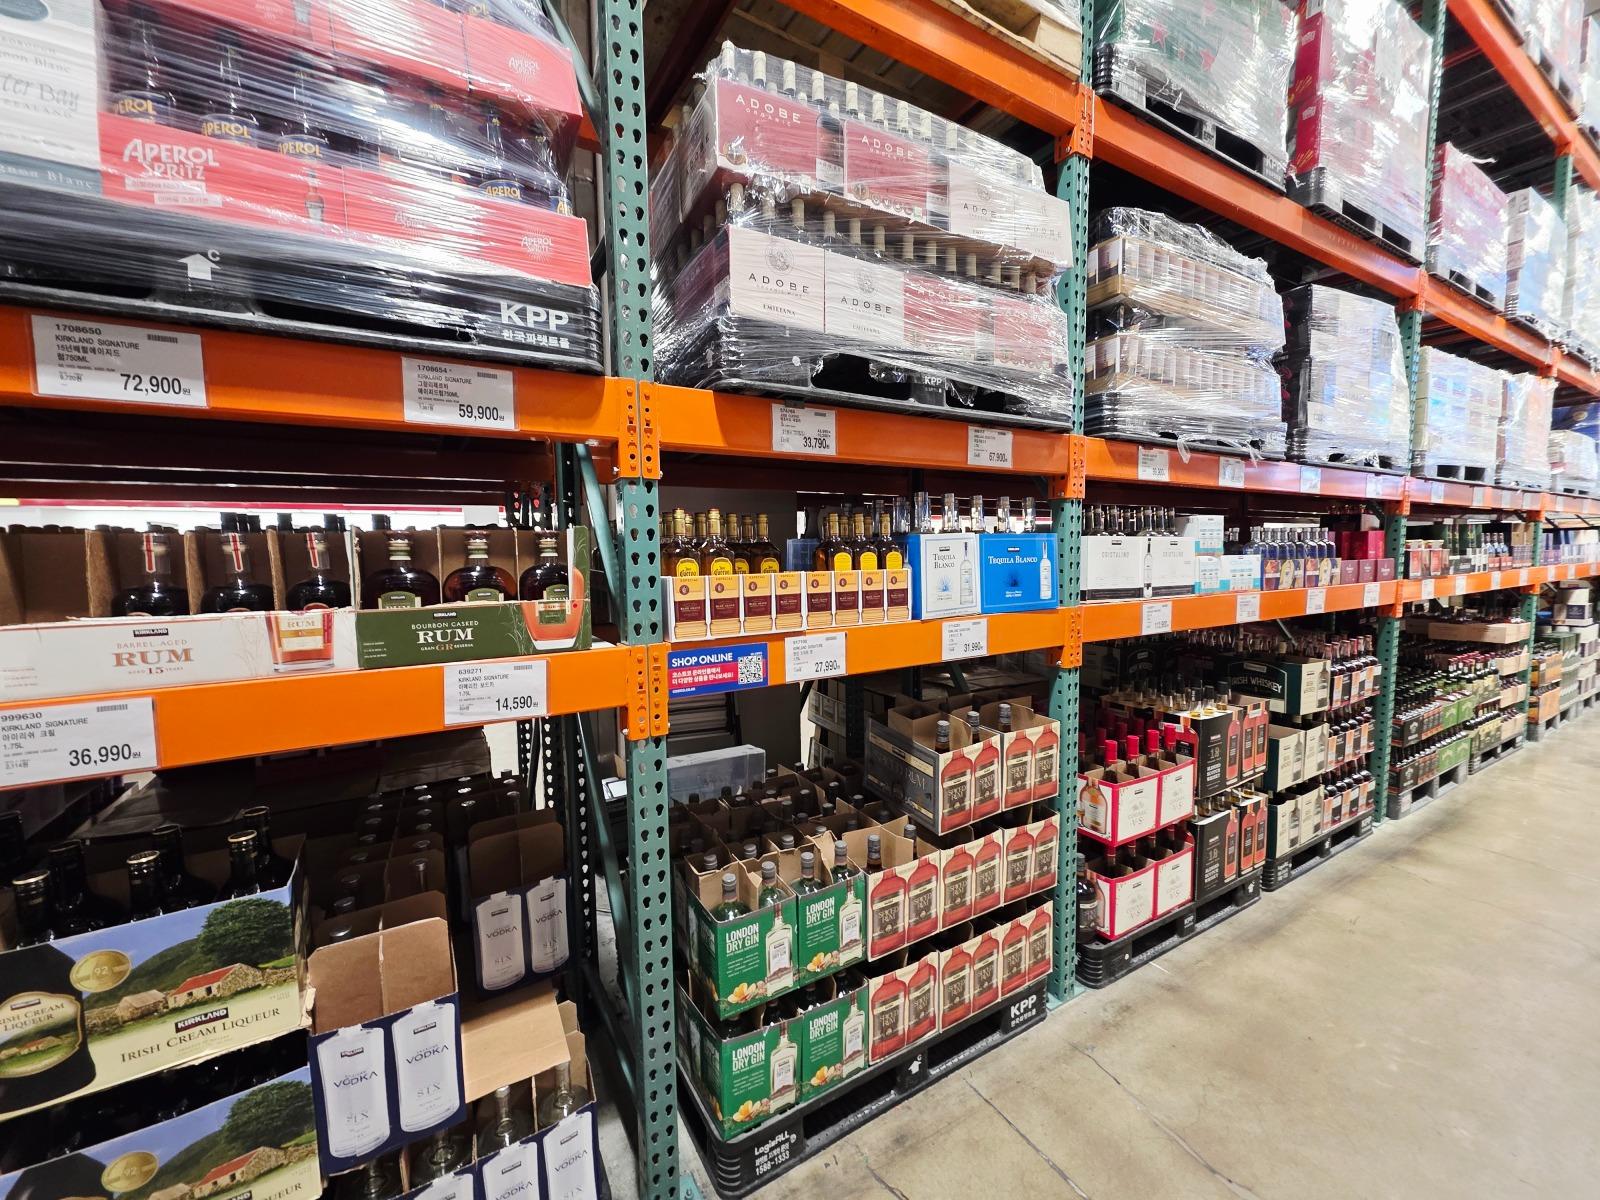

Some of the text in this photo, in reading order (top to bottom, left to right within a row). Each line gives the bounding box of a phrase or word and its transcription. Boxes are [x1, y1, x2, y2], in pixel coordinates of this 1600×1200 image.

[1, 73, 33, 96] ter
[736, 94, 801, 124] ADOBE
[122, 138, 220, 168] APEROL
[861, 135, 915, 160] ADOBE
[0, 163, 39, 179] gnon
[486, 185, 523, 200] APEROL
[520, 235, 554, 248] APEROL
[748, 272, 810, 295] ADOBE
[840, 295, 893, 315] ADOBE
[500, 302, 570, 331] KPP
[55, 323, 102, 335] 1708650
[55, 334, 140, 350] KIRKLAND SIGNATURE
[417, 374, 473, 385] KIRKLAND SIGNATURE
[924, 376, 943, 386] KPP
[133, 628, 169, 638] KIRKLAND
[287, 620, 317, 629] RUM
[411, 620, 479, 630] BOURBON CASKED
[117, 639, 188, 650] BARREL AGED
[416, 627, 475, 645] RUM
[112, 648, 195, 668] RUM
[671, 652, 733, 668] SHOP ONLINE
[148, 667, 165, 675] 15
[1250, 675, 1283, 694] WHISKEY
[0, 711, 42, 722] 999630
[1, 718, 89, 733] KIRKLAND SIGNATURE
[40, 729, 56, 738] 크림
[906, 768, 926, 791] RUM
[806, 896, 835, 915] LONDON
[806, 904, 835, 925] DRY GIN
[535, 909, 563, 924] VODKA
[485, 926, 518, 939] VODKA
[726, 922, 760, 943] LONDON
[726, 939, 743, 954] DRY
[744, 932, 760, 947] GIN
[24, 1002, 66, 1020] CREAM
[1010, 994, 1037, 1019] KPP
[3, 1012, 55, 1032] LIQUEUR
[176, 1007, 229, 1029] KIRKLAND
[809, 1010, 839, 1030] LONDON
[120, 1042, 162, 1064] IRISH
[166, 1024, 218, 1048] CREAM
[221, 1007, 282, 1031] LIQUEUR
[809, 1019, 839, 1041] DRY GIN
[405, 1044, 449, 1065] VODKA
[732, 1040, 766, 1061] LONDON
[732, 1050, 766, 1071] DRY GIN
[333, 1071, 378, 1088] VODKA
[754, 1131, 790, 1156] LogisALL
[553, 1149, 588, 1173] VODKA
[755, 1150, 790, 1176] 1588-1333
[495, 1180, 534, 1200] VODKA
